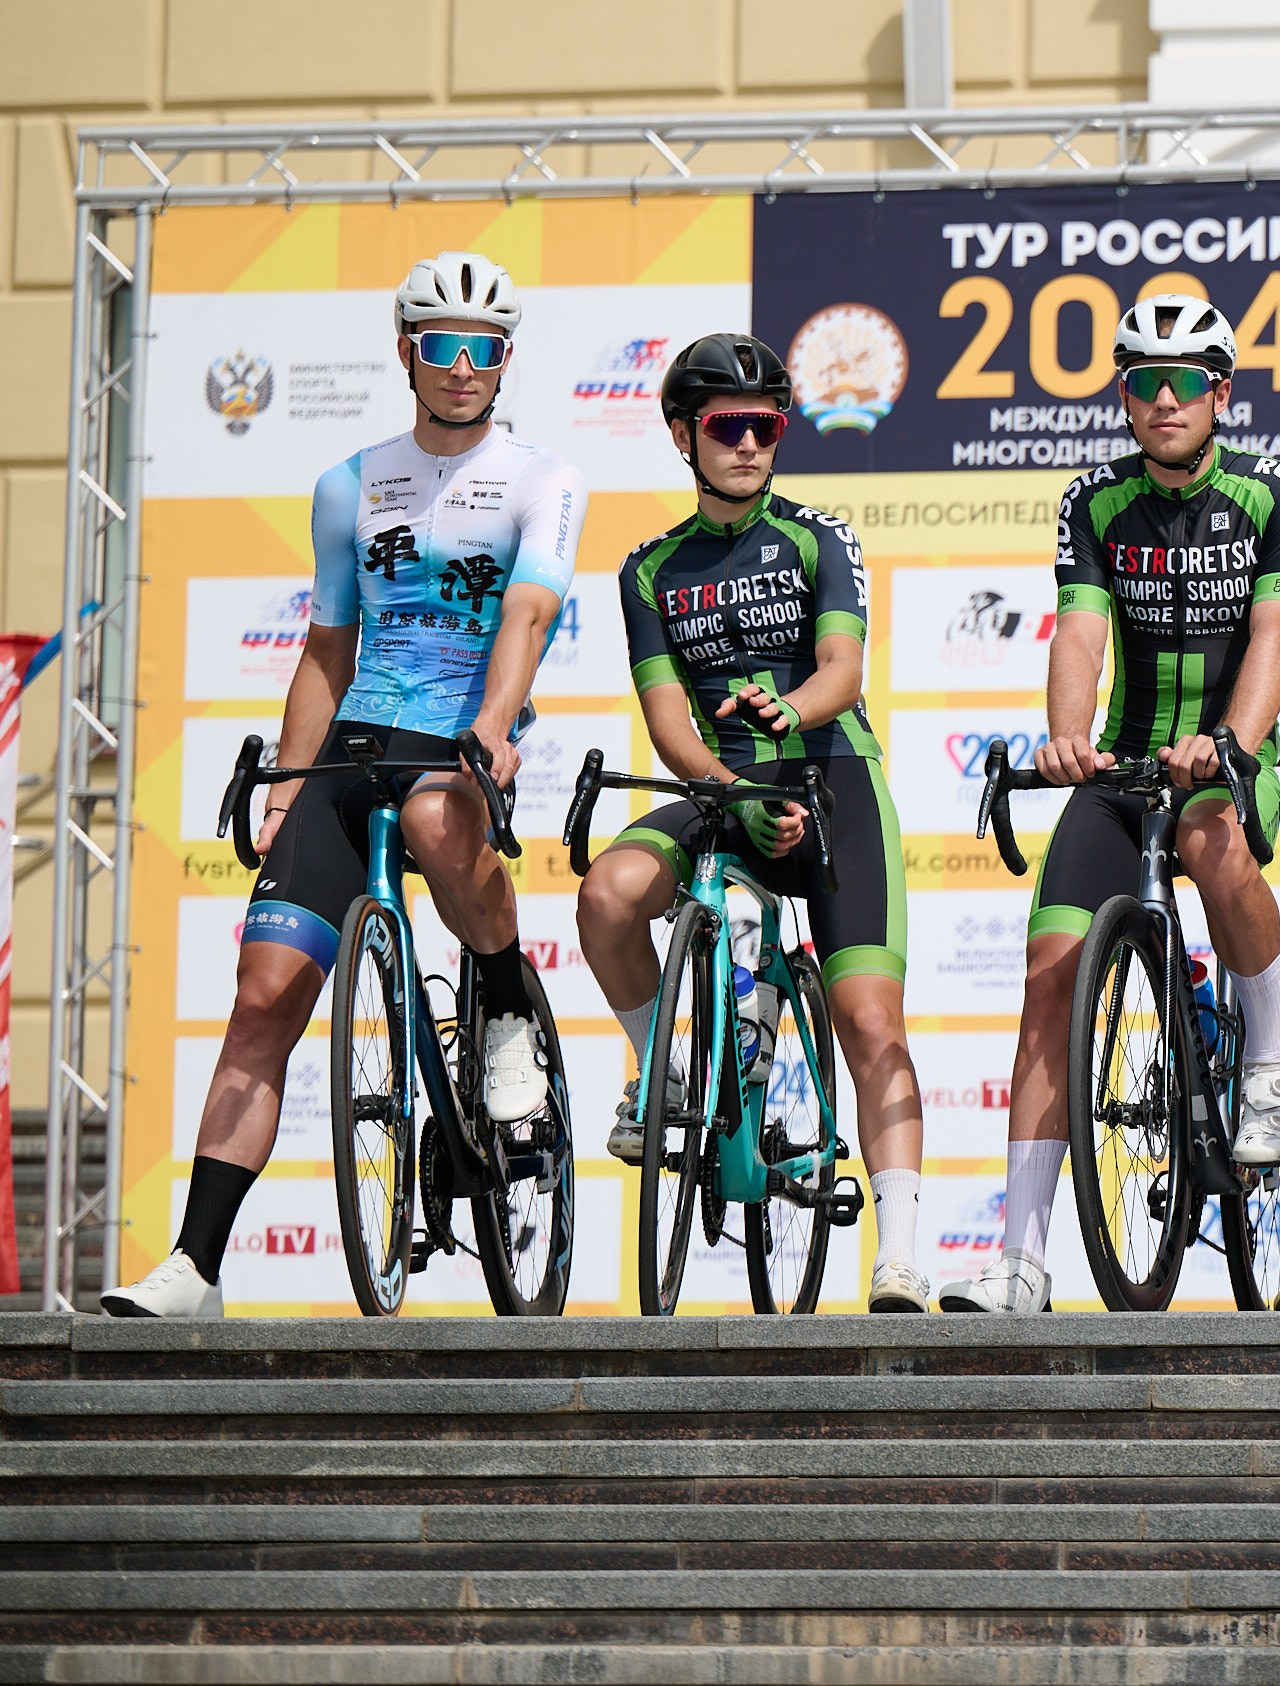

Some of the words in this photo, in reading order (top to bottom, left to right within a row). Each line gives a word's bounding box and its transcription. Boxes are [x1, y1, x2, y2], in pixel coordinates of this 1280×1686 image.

[942, 221, 1049, 269] ТУР
[990, 402, 1252, 434] МЕЖДУНААЯ
[371, 477, 412, 487] LYKOS
[1055, 464, 1116, 567] RUSSIA
[555, 489, 573, 561] PINGTAN
[1213, 521, 1227, 529] CAT
[458, 539, 493, 549] PINGTAN
[1062, 590, 1077, 599] FAT
[1113, 575, 1173, 601] OLYMPIC
[1187, 575, 1254, 601] SCHOOL
[1062, 597, 1077, 605] CAT
[738, 600, 807, 629] SCHOOL
[452, 647, 468, 658] PASS
